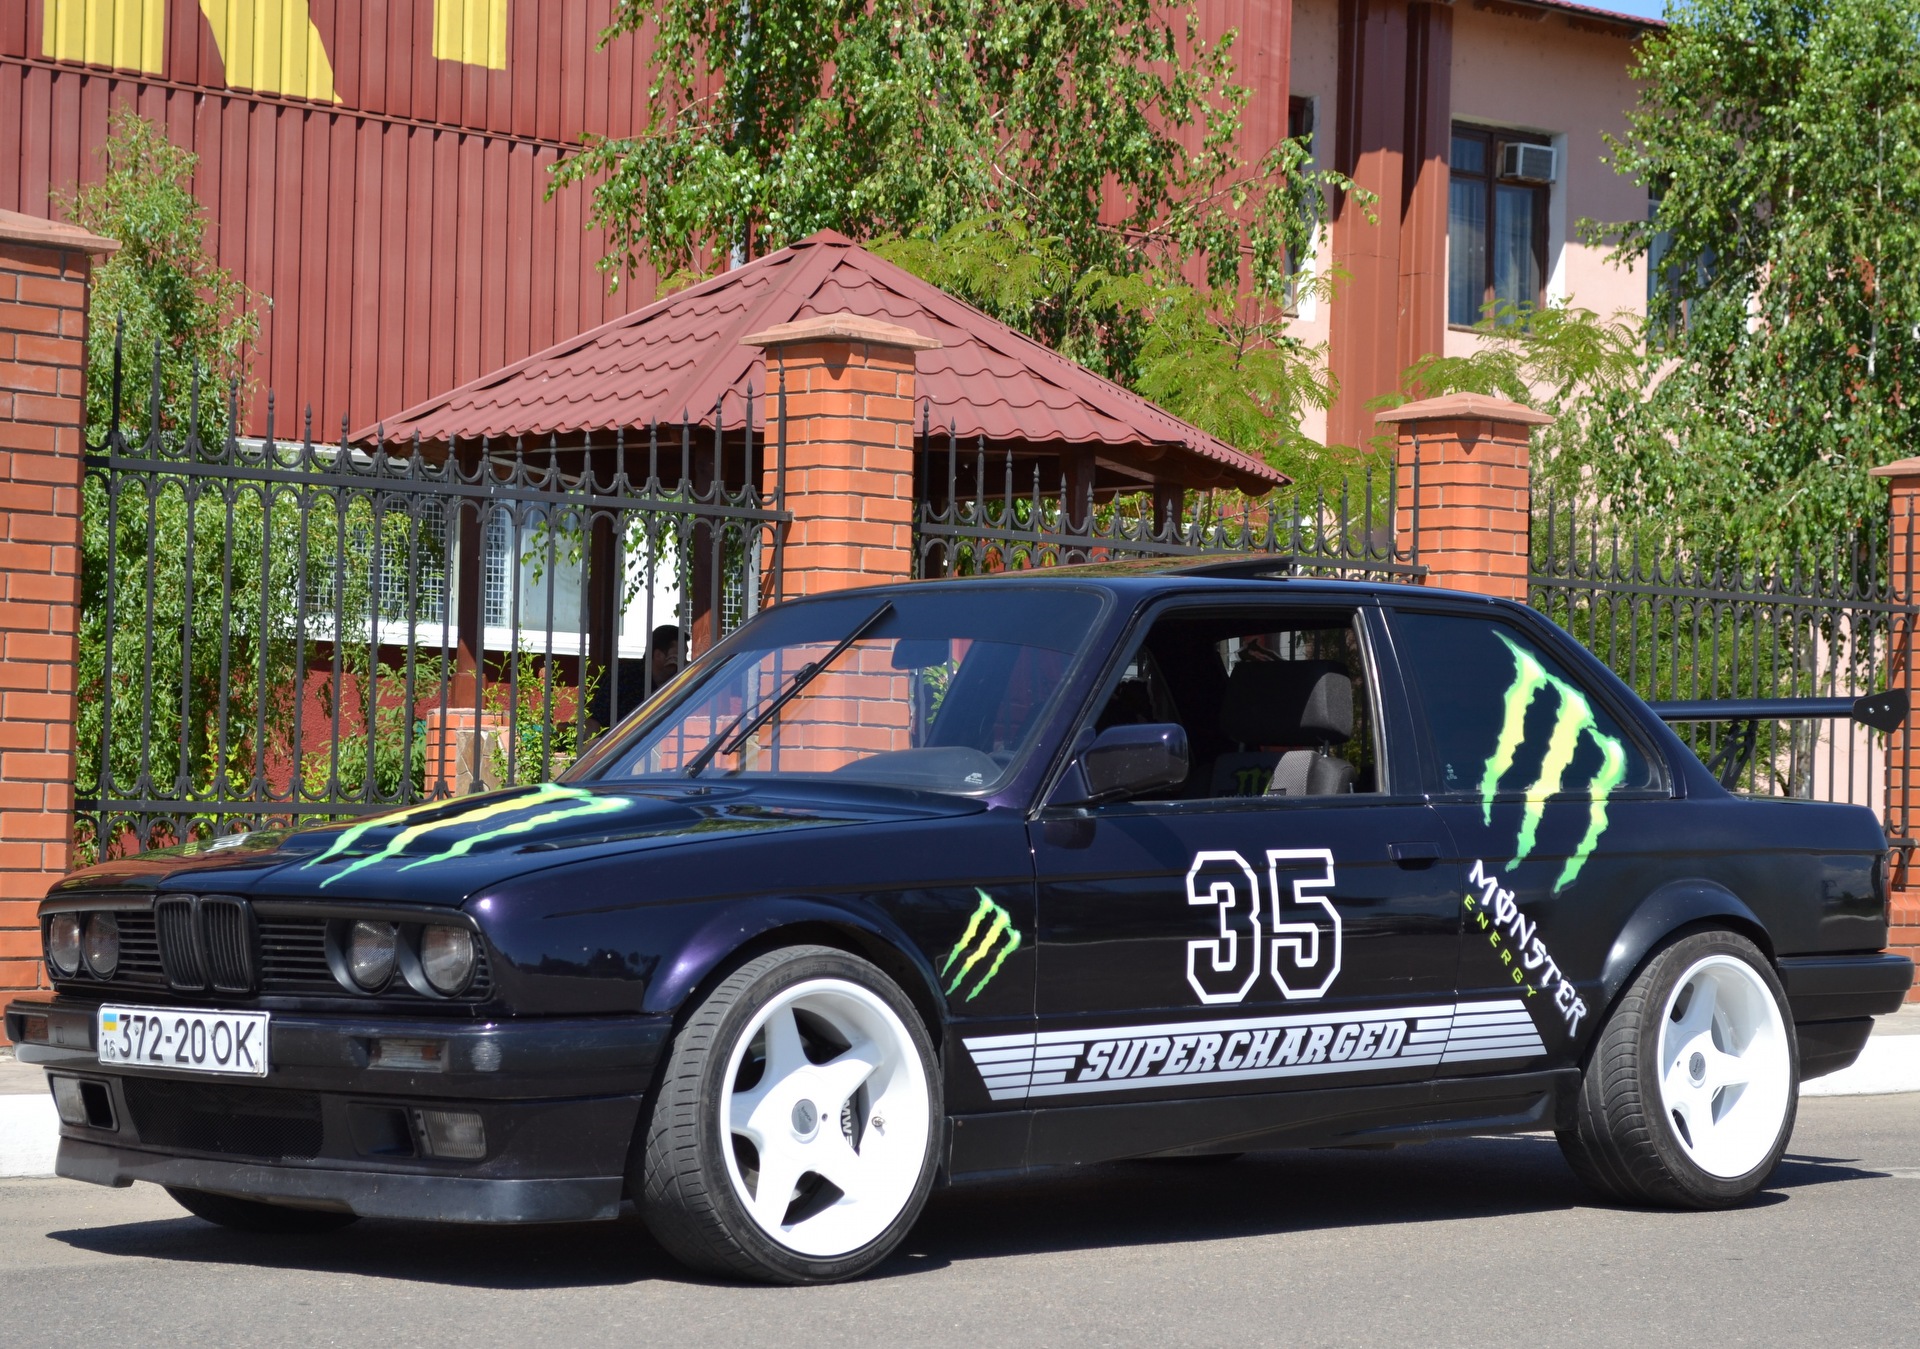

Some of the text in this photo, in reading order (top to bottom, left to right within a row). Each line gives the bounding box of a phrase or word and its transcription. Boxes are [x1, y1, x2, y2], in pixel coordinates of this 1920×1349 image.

[1186, 848, 1342, 1004] 35
[1463, 893, 1538, 998] ENERGY
[102, 1038, 117, 1060] 16
[1076, 1019, 1409, 1082] SUPERCHARGED
